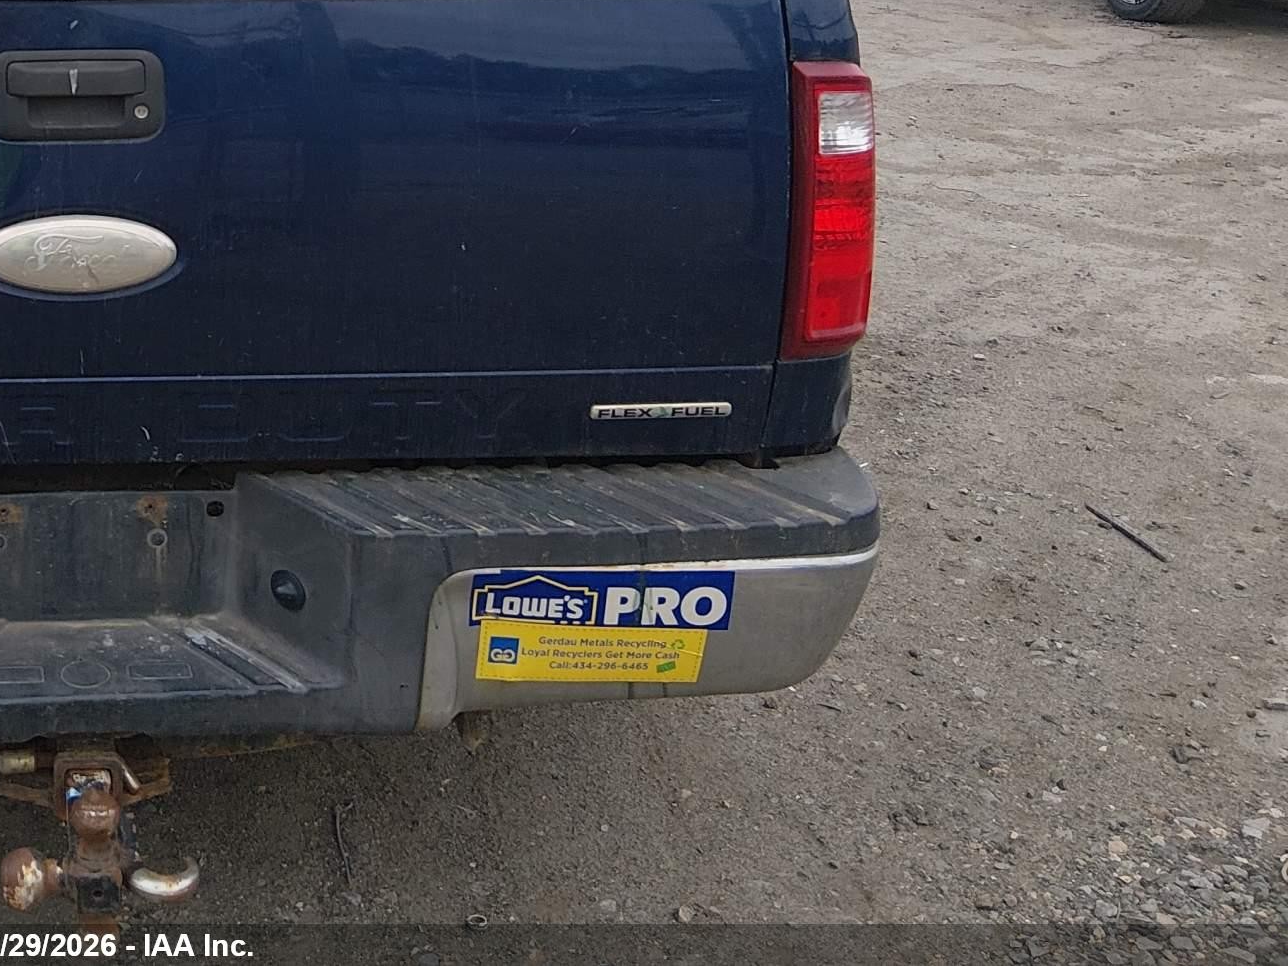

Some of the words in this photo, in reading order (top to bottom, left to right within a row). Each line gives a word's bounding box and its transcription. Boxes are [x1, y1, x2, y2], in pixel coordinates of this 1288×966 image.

[598, 408, 653, 418] FLEX
[671, 406, 726, 417] FUEL
[484, 592, 585, 619] LOWE'S
[603, 586, 728, 627] PRO
[538, 636, 577, 647] Gerdau
[579, 638, 614, 648] Metals
[616, 639, 667, 650] Recycling
[521, 648, 550, 659] Loyal
[552, 650, 602, 661] Recyclers
[605, 650, 624, 660] Get
[626, 651, 652, 660] More
[654, 651, 680, 661] Cash
